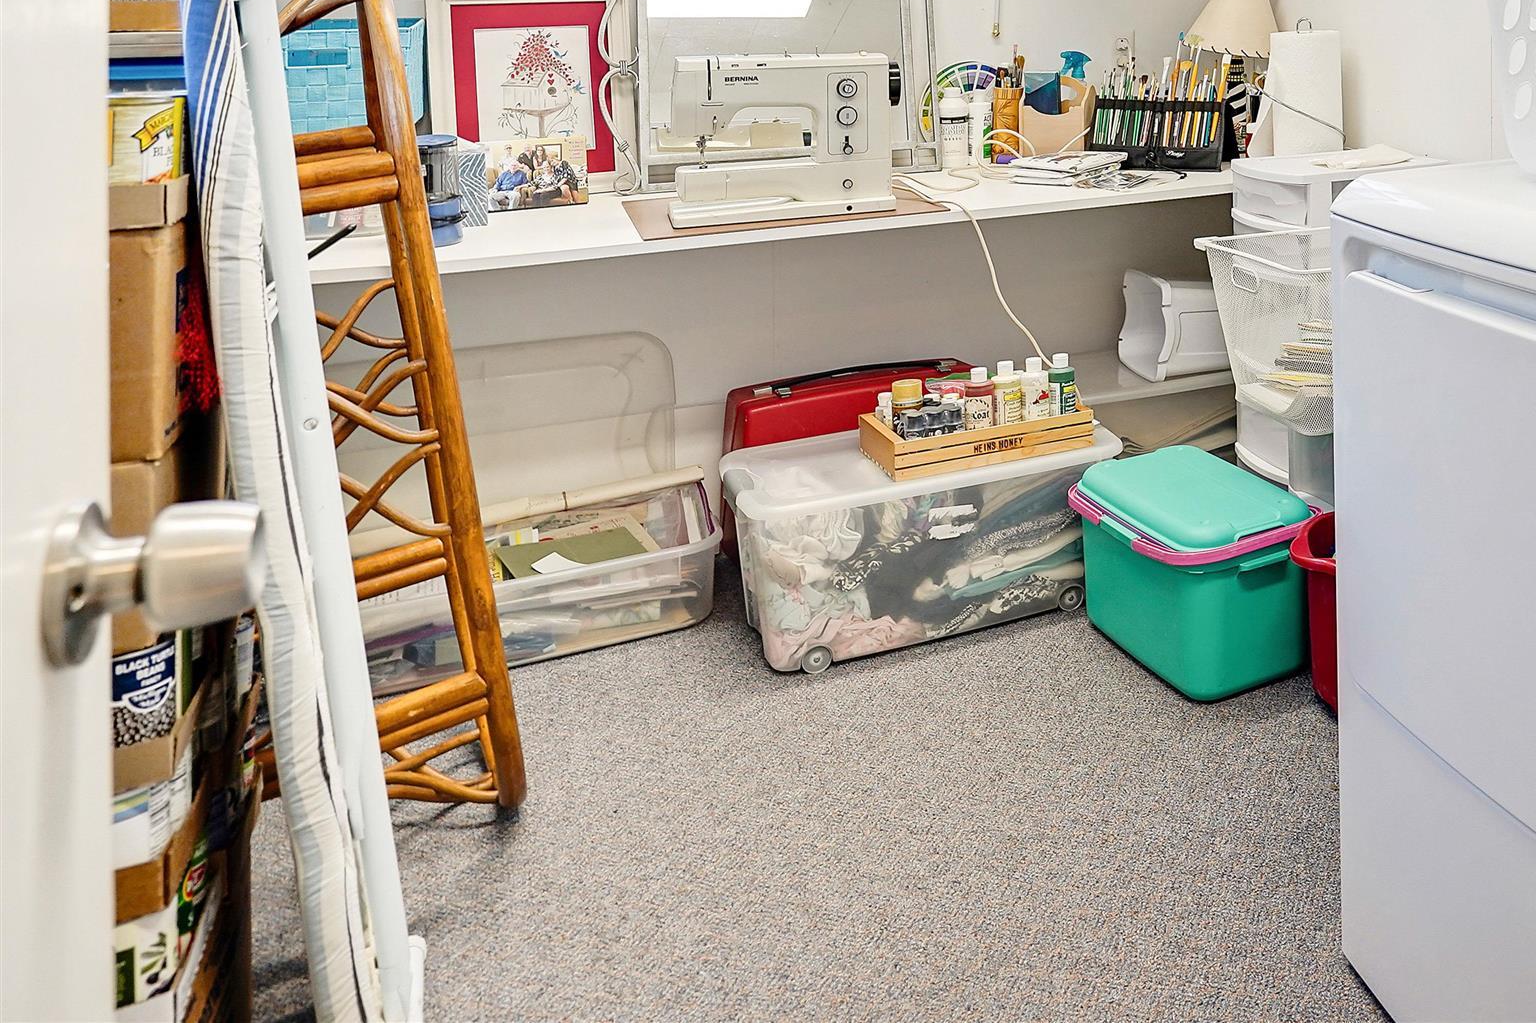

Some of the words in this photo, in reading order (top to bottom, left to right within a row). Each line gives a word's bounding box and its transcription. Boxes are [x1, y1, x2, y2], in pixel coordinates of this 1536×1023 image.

[973, 439, 997, 454] HEINS
[999, 436, 1024, 452] HONEY
[115, 657, 150, 675] BLACK
